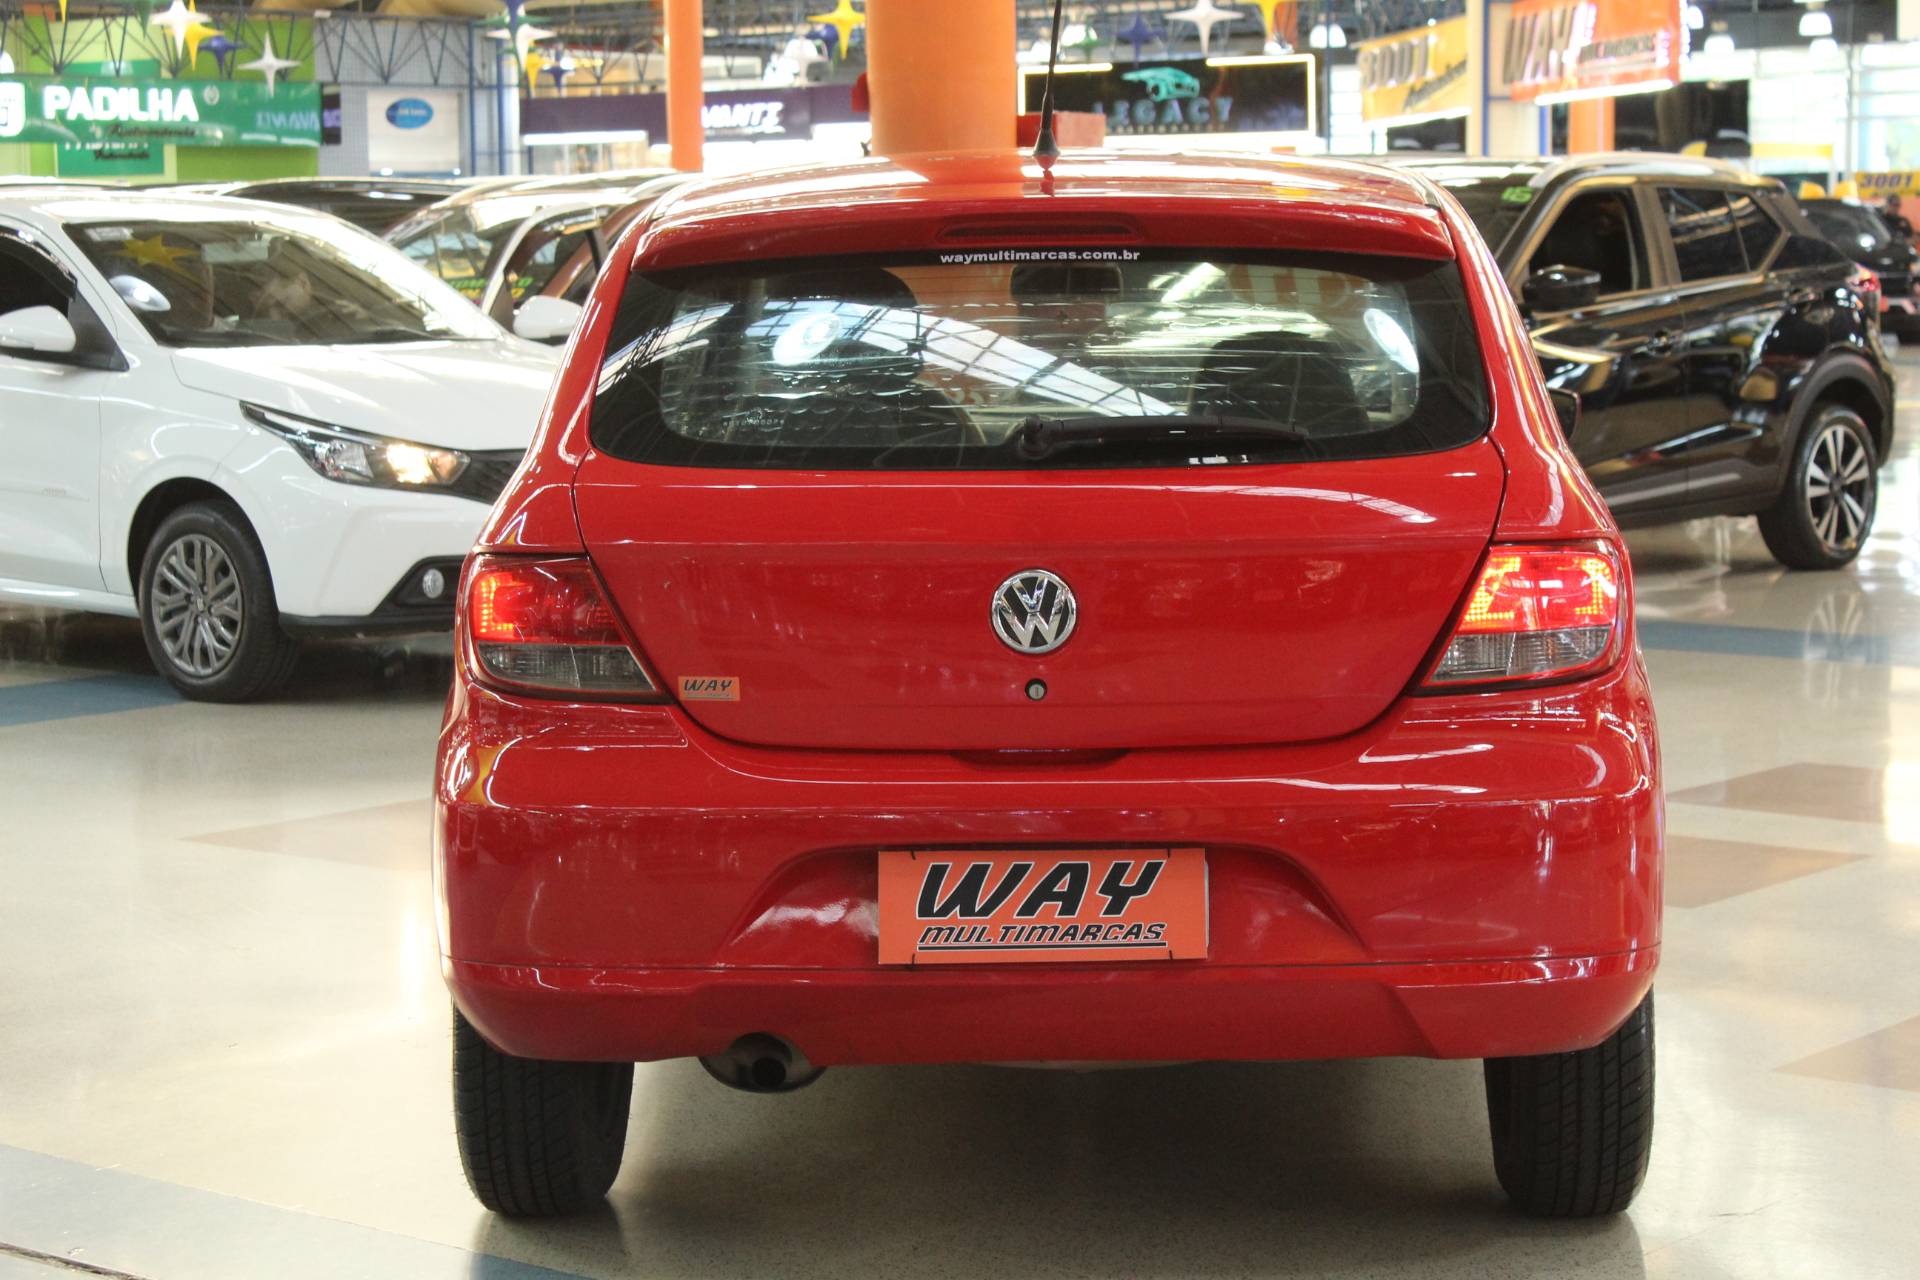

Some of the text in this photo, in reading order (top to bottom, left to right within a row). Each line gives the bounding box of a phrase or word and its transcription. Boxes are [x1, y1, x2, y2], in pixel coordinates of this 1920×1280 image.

[43, 85, 200, 122] PADILHA
[940, 250, 1140, 264] waymultimarcas.com.br
[684, 679, 733, 691] WAY
[916, 860, 1167, 919] WAY
[917, 922, 1168, 944] MULTIMARCAS
